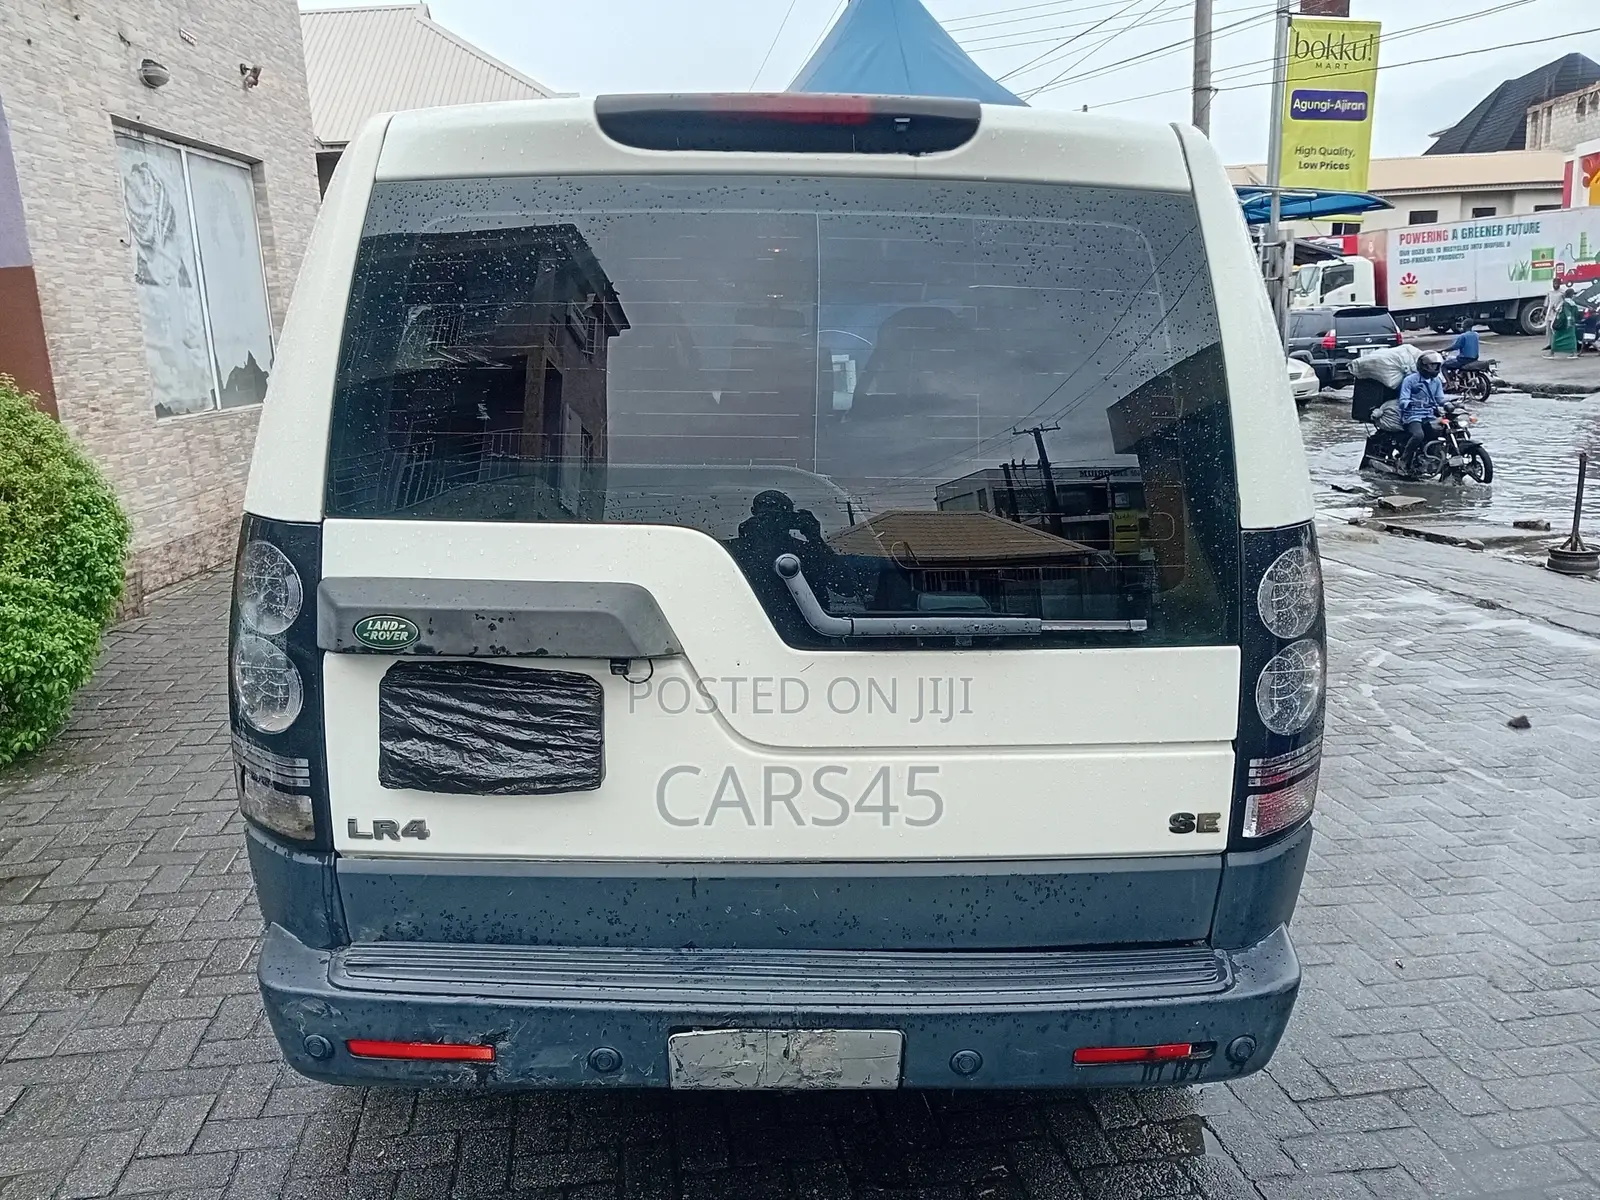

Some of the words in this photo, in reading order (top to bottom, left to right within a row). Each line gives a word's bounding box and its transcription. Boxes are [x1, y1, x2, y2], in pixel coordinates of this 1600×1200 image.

[1294, 31, 1374, 61] bokku!
[1315, 62, 1349, 70] MART
[1293, 98, 1366, 113] Agungi-Ajiran
[1294, 146, 1316, 158] High
[1318, 146, 1356, 158] Quality,
[1298, 160, 1318, 170] Low
[1319, 161, 1350, 171] Prices
[1399, 229, 1449, 246] POWERING
[1451, 228, 1459, 241] A
[1461, 225, 1503, 240] GREENER
[1505, 221, 1541, 236] FUTURE
[366, 620, 399, 631] LAND
[369, 631, 409, 641] ROVER
[1168, 812, 1222, 834] SE
[347, 818, 431, 842] LR4
